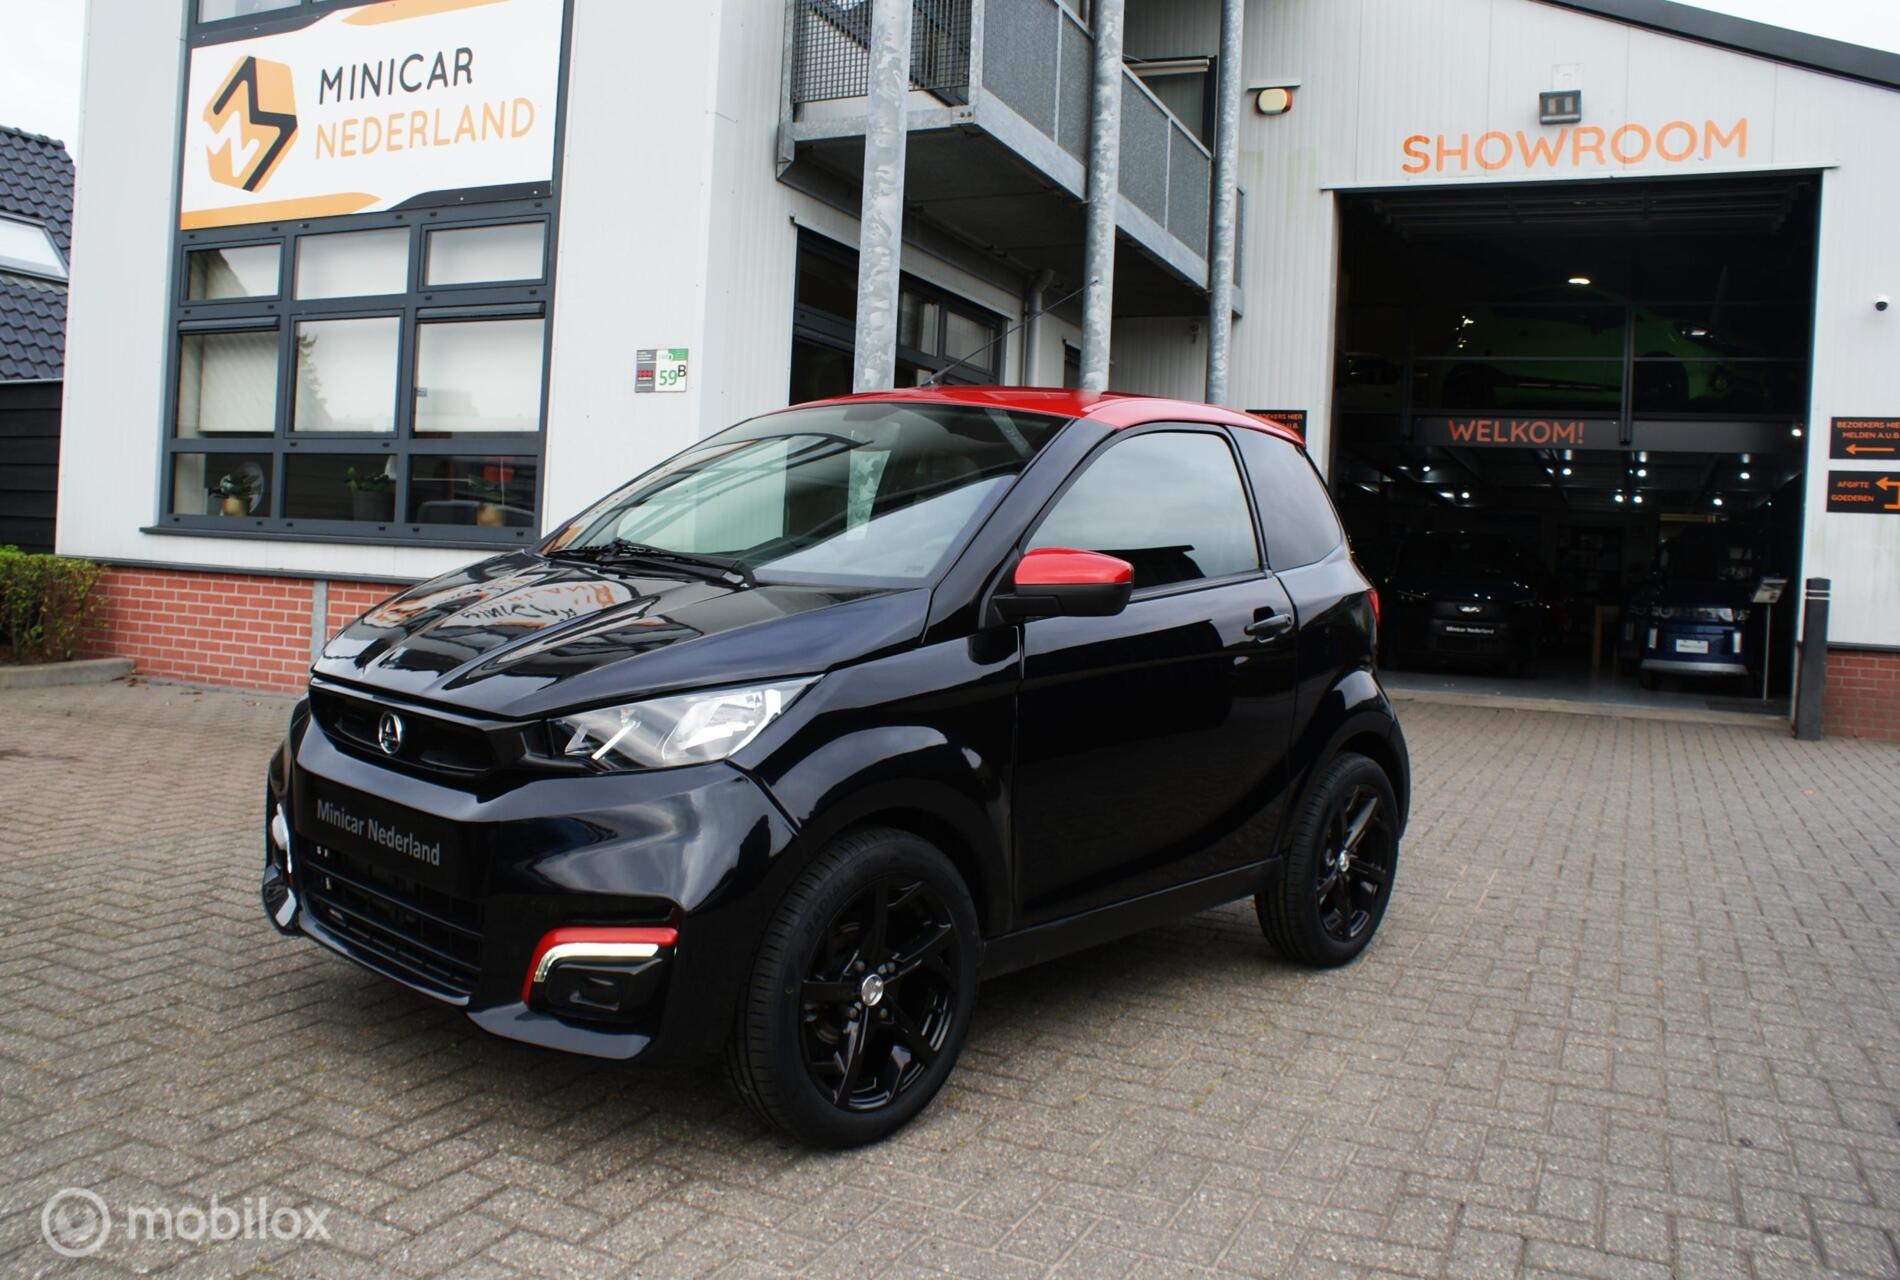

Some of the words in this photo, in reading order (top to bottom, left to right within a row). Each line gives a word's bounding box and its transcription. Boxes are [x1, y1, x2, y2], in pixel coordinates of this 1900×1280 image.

[319, 47, 474, 105] MINICAR
[315, 97, 535, 160] NEDERLAND
[1402, 117, 1747, 173] SHOWROOM
[1448, 418, 1585, 445] WELKOM!
[1836, 421, 1885, 429] BEZOEKERS
[1886, 421, 1900, 429] HIE
[1842, 431, 1876, 439] MELDEN
[1831, 494, 1874, 502] GOEDEREN
[1837, 481, 1870, 489] AFGIFTE
[316, 798, 365, 836] Minicar
[367, 818, 441, 867] Nederland
